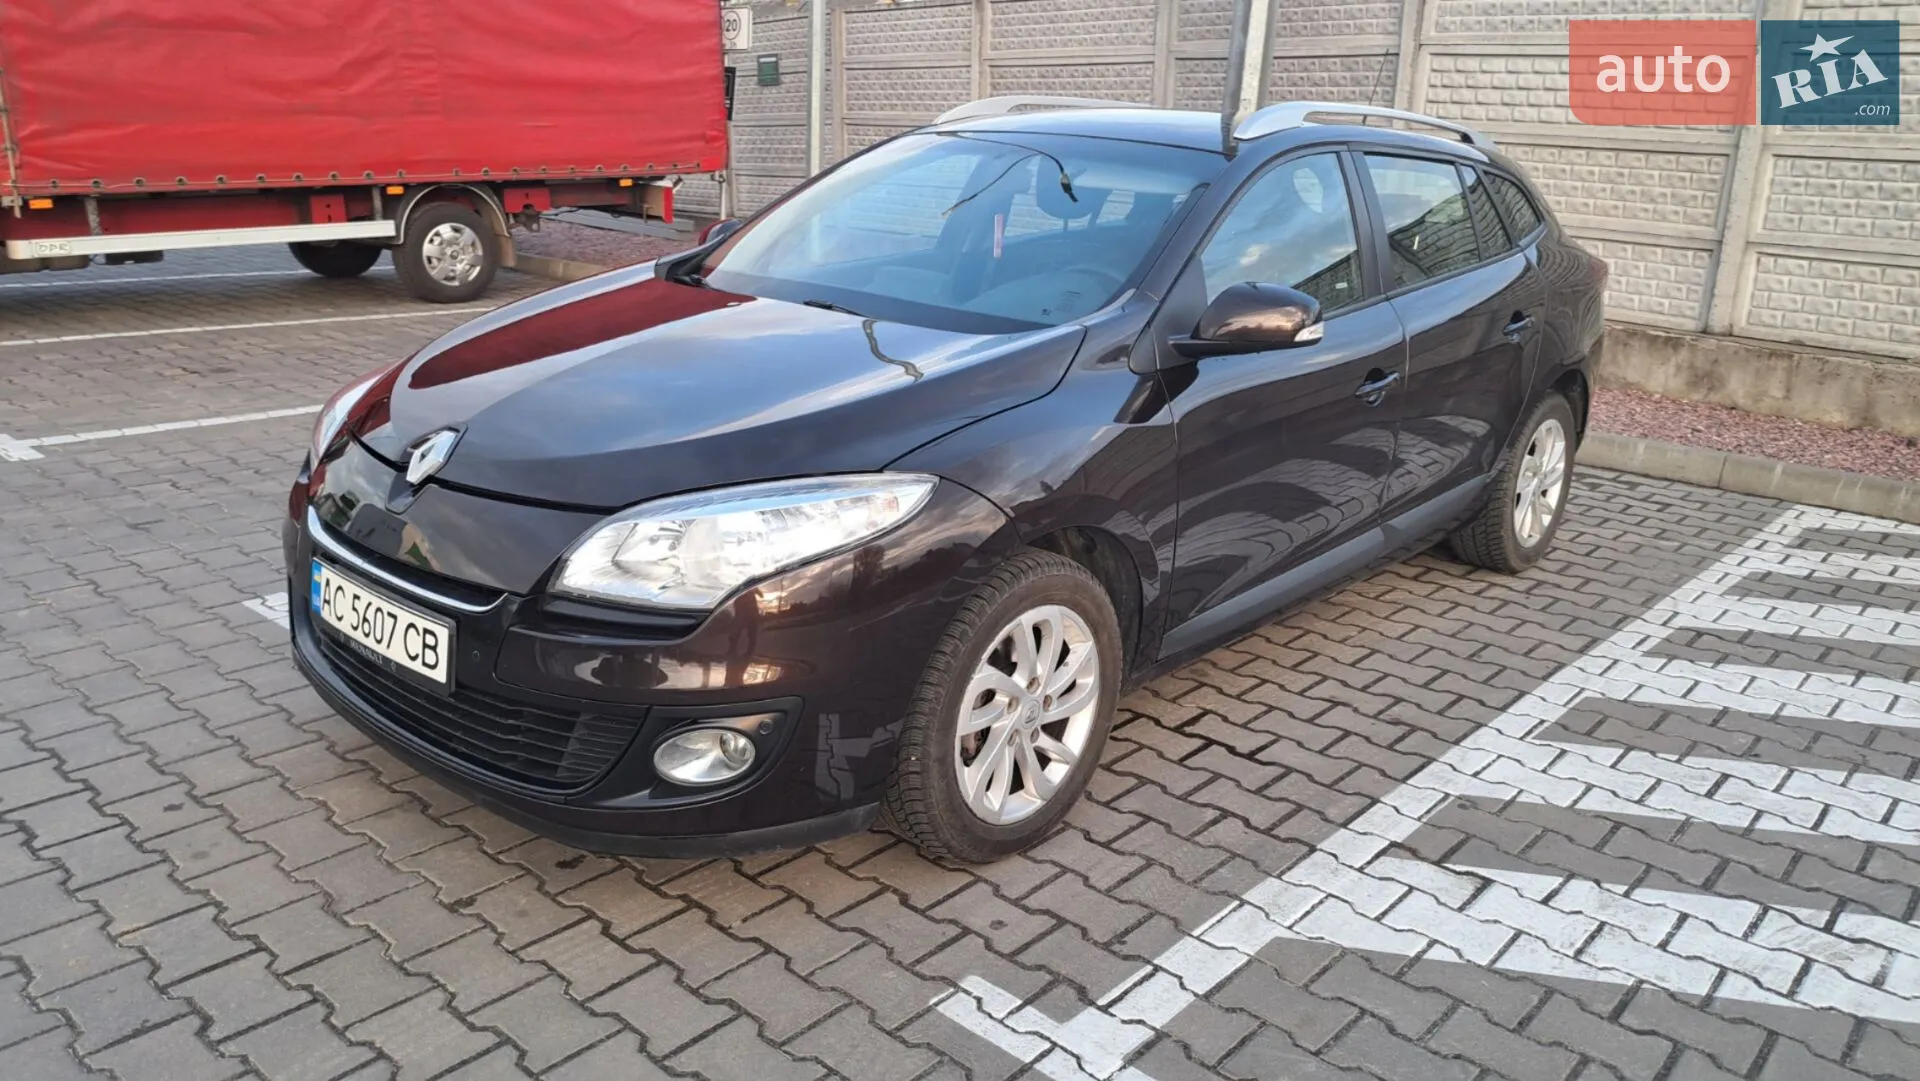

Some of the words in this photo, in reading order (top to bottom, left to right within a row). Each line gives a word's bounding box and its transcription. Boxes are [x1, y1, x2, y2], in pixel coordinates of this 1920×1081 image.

[725, 19, 738, 32] 20
[322, 577, 346, 622] AC
[350, 593, 398, 650] 5607
[403, 622, 440, 671] CB
